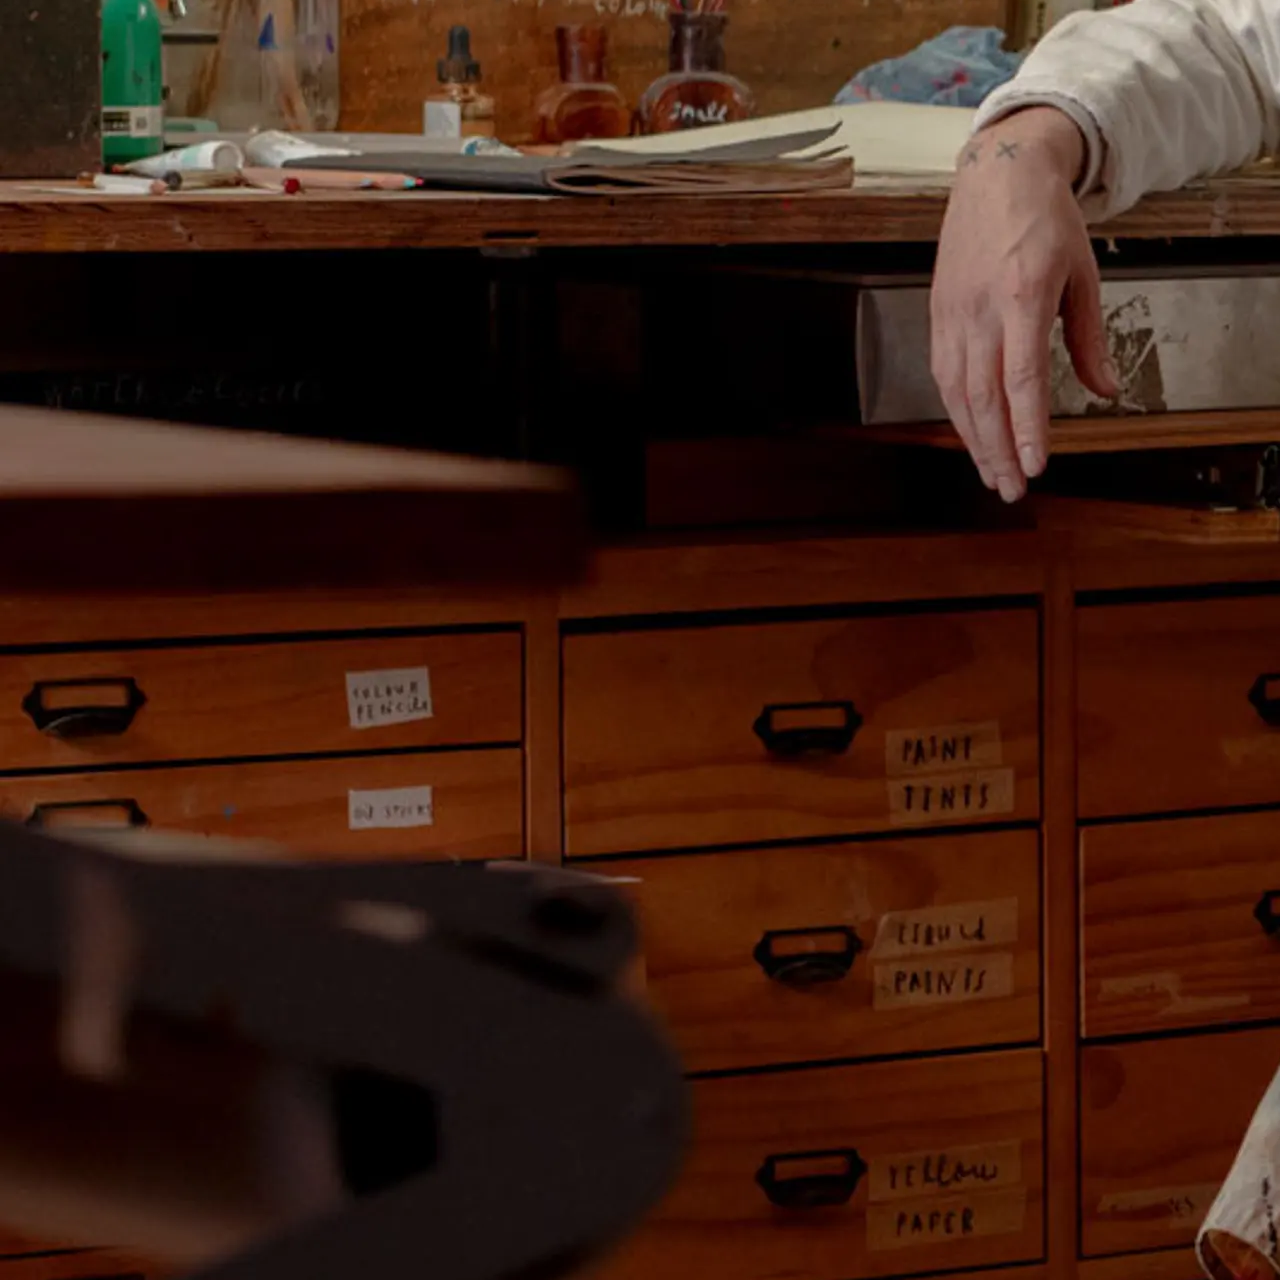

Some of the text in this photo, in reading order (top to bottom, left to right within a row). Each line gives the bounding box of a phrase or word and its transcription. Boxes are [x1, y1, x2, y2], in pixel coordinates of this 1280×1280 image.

[902, 735, 972, 765] PAINT
[904, 782, 989, 812] TINTS
[895, 968, 987, 995] PAINTS
[897, 1206, 973, 1236] PAPER
